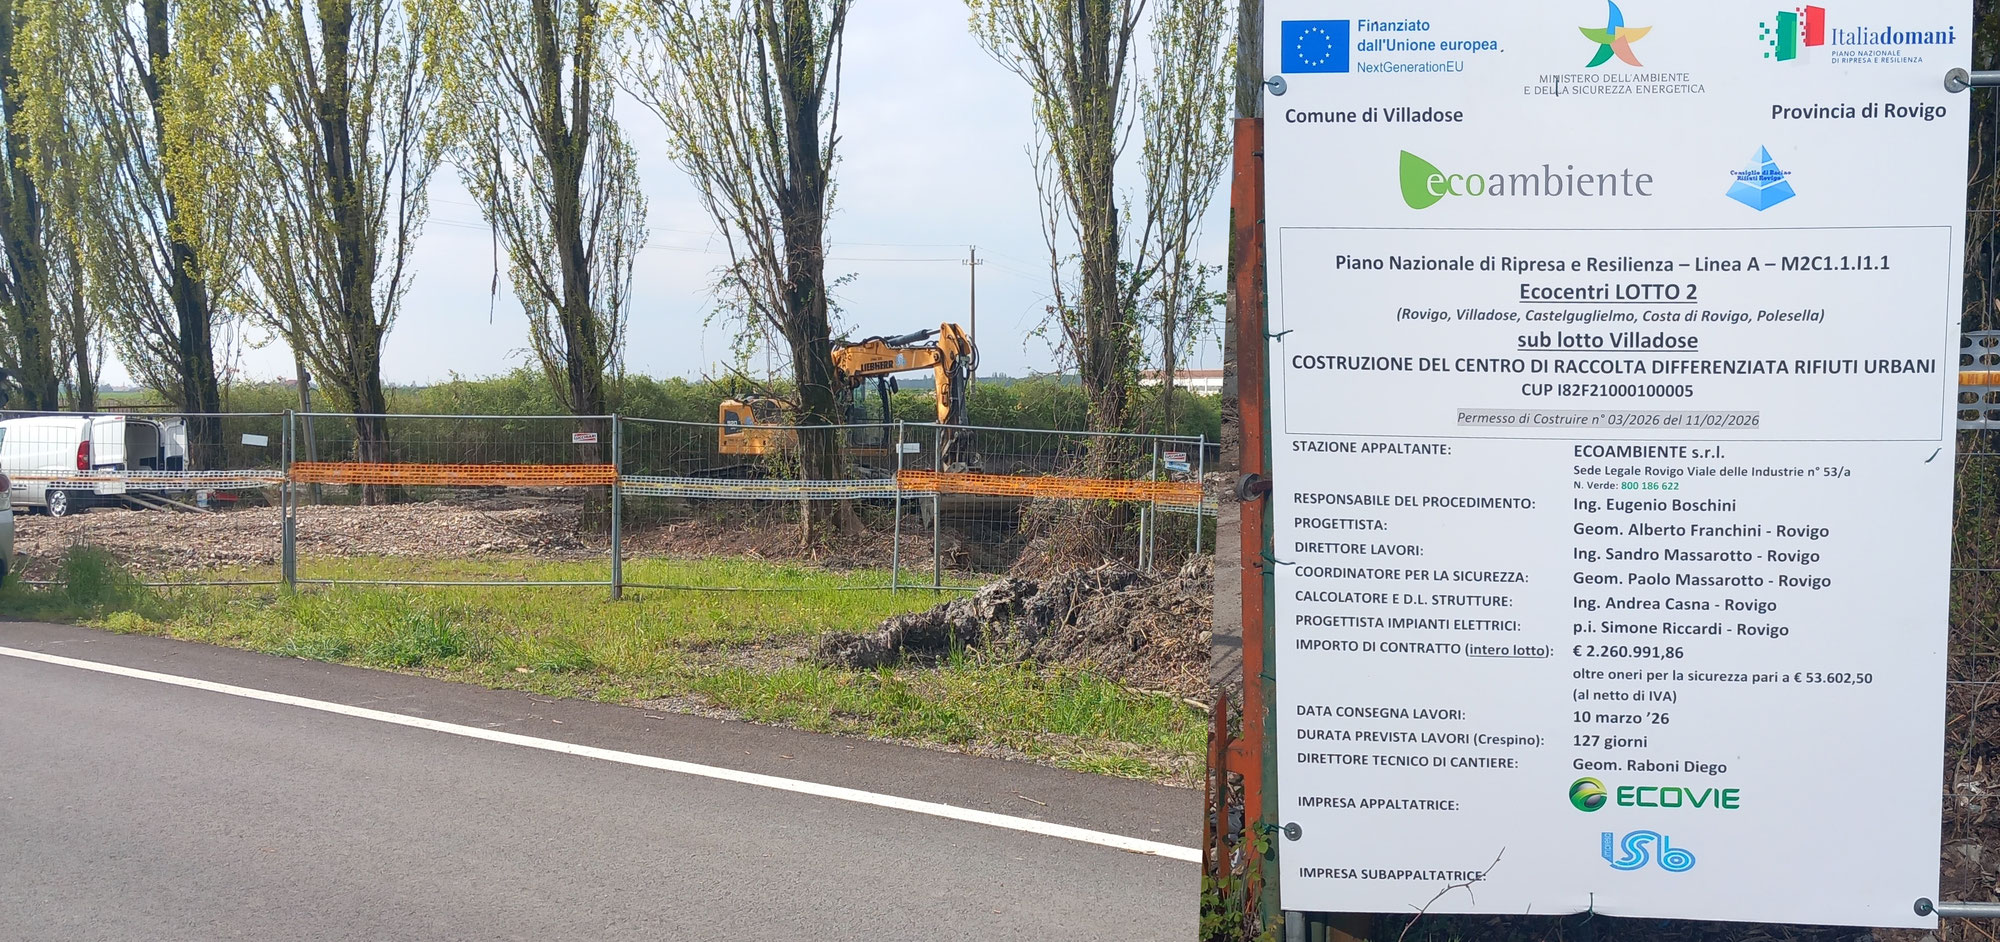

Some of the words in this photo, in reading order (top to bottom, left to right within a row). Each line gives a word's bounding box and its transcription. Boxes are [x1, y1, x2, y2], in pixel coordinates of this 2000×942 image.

[1358, 19, 1430, 32] Finanziato
[1832, 26, 1954, 45] Italiadomani
[1358, 39, 1435, 52] dall'Unione
[1440, 40, 1497, 53] europea
[1358, 61, 1463, 73] NextGenerationEU
[1540, 74, 1599, 83] MINISTERO
[1603, 73, 1689, 82] DELL'AMBIENTE
[1524, 86, 1530, 94] E
[1535, 86, 1569, 94] DELLA
[1573, 85, 1632, 94] SICUREZZA
[1636, 84, 1705, 93] ENERGETICA
[1286, 108, 1356, 123] Comune
[1363, 107, 1377, 123] di
[1383, 107, 1463, 123] Villadose
[1772, 104, 1855, 119] Provincia
[1862, 103, 1877, 118] di
[1885, 102, 1946, 121] Rovigo
[1426, 165, 1653, 198] ecoambiente
[1336, 255, 1384, 271] Piano
[1390, 256, 1474, 271] Nazionale
[1480, 256, 1496, 271] di
[1501, 257, 1565, 275] Ripresa
[1571, 260, 1580, 271] e
[1587, 257, 1674, 272] Resilienza
[1695, 257, 1741, 272] Linea
[1747, 258, 1760, 271] A
[1781, 255, 1890, 271] M2C1.1.I1.1
[1520, 284, 1609, 300] Ecocentri
[1615, 284, 1680, 300] LOTTO
[1686, 284, 1697, 300] 2
[1397, 307, 1451, 323] (Rovigo,
[1457, 309, 1520, 323] Villadose,
[1525, 309, 1638, 325] Castelguglielmo,
[1643, 310, 1680, 322] Costa
[1685, 309, 1697, 322] di
[1701, 309, 1752, 324] Rovigo,
[1757, 309, 1825, 324] Polesella)
[1518, 331, 1551, 348] sub
[1557, 331, 1604, 348] lotto
[1610, 332, 1698, 349] Villadose
[861, 360, 893, 371] LIEBHERR
[1292, 355, 1413, 372] COSTRUZIONE
[1419, 357, 1450, 372] DEL
[1455, 358, 1525, 374] CENTRO
[1530, 359, 1548, 374] DI
[1554, 359, 1646, 374] RACCOLTA
[1653, 359, 1788, 375] DIFFERENZIATA
[1795, 359, 1857, 375] RIFIUTI
[1864, 358, 1935, 374] URBANI
[1521, 383, 1552, 397] CUP
[1558, 384, 1693, 397] I82F21000100005
[1458, 412, 1515, 426] Permesso
[1519, 412, 1530, 424] di
[1534, 413, 1588, 425] Costruire
[1592, 414, 1605, 425] n°
[1608, 413, 1660, 426] 03/2026
[1664, 414, 1682, 426] del
[1685, 414, 1759, 427] 11/02/2026
[1293, 440, 1357, 453] STAZIONE
[1361, 442, 1451, 455] APPALTANTE:
[1574, 445, 1687, 458] ECOAMBIENTE
[1692, 445, 1724, 458] s.r.l.
[1574, 466, 1601, 475] Sede
[1605, 466, 1641, 478] Legale
[1645, 466, 1684, 478] Rovigo
[1687, 467, 1716, 477] Viale
[1719, 467, 1747, 477] delle
[1752, 467, 1804, 477] Industrie
[1808, 467, 1820, 477] n°
[1823, 466, 1851, 478] 53/a
[1574, 481, 1584, 490] N.
[1587, 481, 1619, 490] Verde:
[1621, 482, 1638, 490] 800
[1642, 482, 1658, 490] 186
[1662, 482, 1679, 491] 622
[1294, 493, 1390, 506] RESPONSABILE
[1395, 495, 1418, 507] DEL
[1423, 496, 1535, 509] PROCEDIMENTO:
[1574, 498, 1601, 513] Ing.
[1606, 498, 1667, 514] Eugenio
[1672, 499, 1736, 512] Boschini
[1295, 518, 1387, 531] PROGETTISTA:
[1295, 541, 1366, 555] DIRETTORE
[1371, 543, 1423, 556] LAVORI:
[1295, 566, 1401, 580] COORDINATORE
[1405, 569, 1429, 581] PER
[1433, 569, 1449, 581] LA
[1453, 570, 1529, 583] SICUREZZA:
[1295, 590, 1389, 604] CALCOLATORE
[1393, 593, 1399, 604] E
[1404, 594, 1428, 606] D.L.
[1432, 594, 1513, 607] STRUTTURE:
[1296, 615, 1384, 629] PROGETTISTA
[1388, 618, 1449, 630] IMPIANTI
[1454, 619, 1521, 632] ELETTRICI:
[1296, 639, 1358, 652] IMPORTO
[1363, 641, 1376, 652] DI
[1380, 641, 1461, 654] CONTRATTO
[1465, 644, 1509, 657] (intero
[1513, 645, 1554, 658] lotto):
[1573, 646, 1582, 657] €
[1587, 645, 1684, 660] 2.260.991,86
[1573, 668, 1604, 680] oltre
[1608, 669, 1642, 680] oneri
[1646, 671, 1669, 683] per
[1673, 670, 1684, 681] la
[1688, 670, 1748, 682] sicurezza
[1752, 672, 1778, 684] pari
[1782, 674, 1789, 683] a
[1794, 673, 1802, 683] €
[1806, 672, 1872, 685] 53.602,50
[1573, 689, 1589, 702] (al
[1592, 690, 1629, 701] netto
[1633, 690, 1645, 701] di
[1649, 690, 1677, 703] IVA)
[1297, 705, 1332, 717] DATA
[1336, 706, 1409, 719] CONSEGNA
[1413, 708, 1465, 720] LAVORI:
[1573, 711, 1591, 723] 10
[1596, 713, 1642, 724] marzo
[1297, 729, 1351, 741] DURATA
[1355, 731, 1417, 743] PREVISTA
[1421, 733, 1469, 745] LAVORI
[1474, 733, 1544, 748] (Crespino):
[1573, 735, 1599, 747] 127
[1604, 735, 1647, 750] giorni
[1298, 752, 1368, 765] DIRETTORE
[1373, 755, 1429, 767] TECNICO
[1433, 756, 1446, 767] DI
[1450, 756, 1518, 769] CANTIERE:
[1573, 758, 1622, 771] Geom.
[1627, 759, 1679, 772] Raboni
[1684, 760, 1727, 775] Diego
[1298, 796, 1356, 808] IMPRESA
[1360, 798, 1459, 811] APPALTATRICE:
[1617, 786, 1740, 809] ECOVIE
[1299, 867, 1357, 880] IMPRESA
[1361, 869, 1486, 882] SUBAPPALTATRICE:
